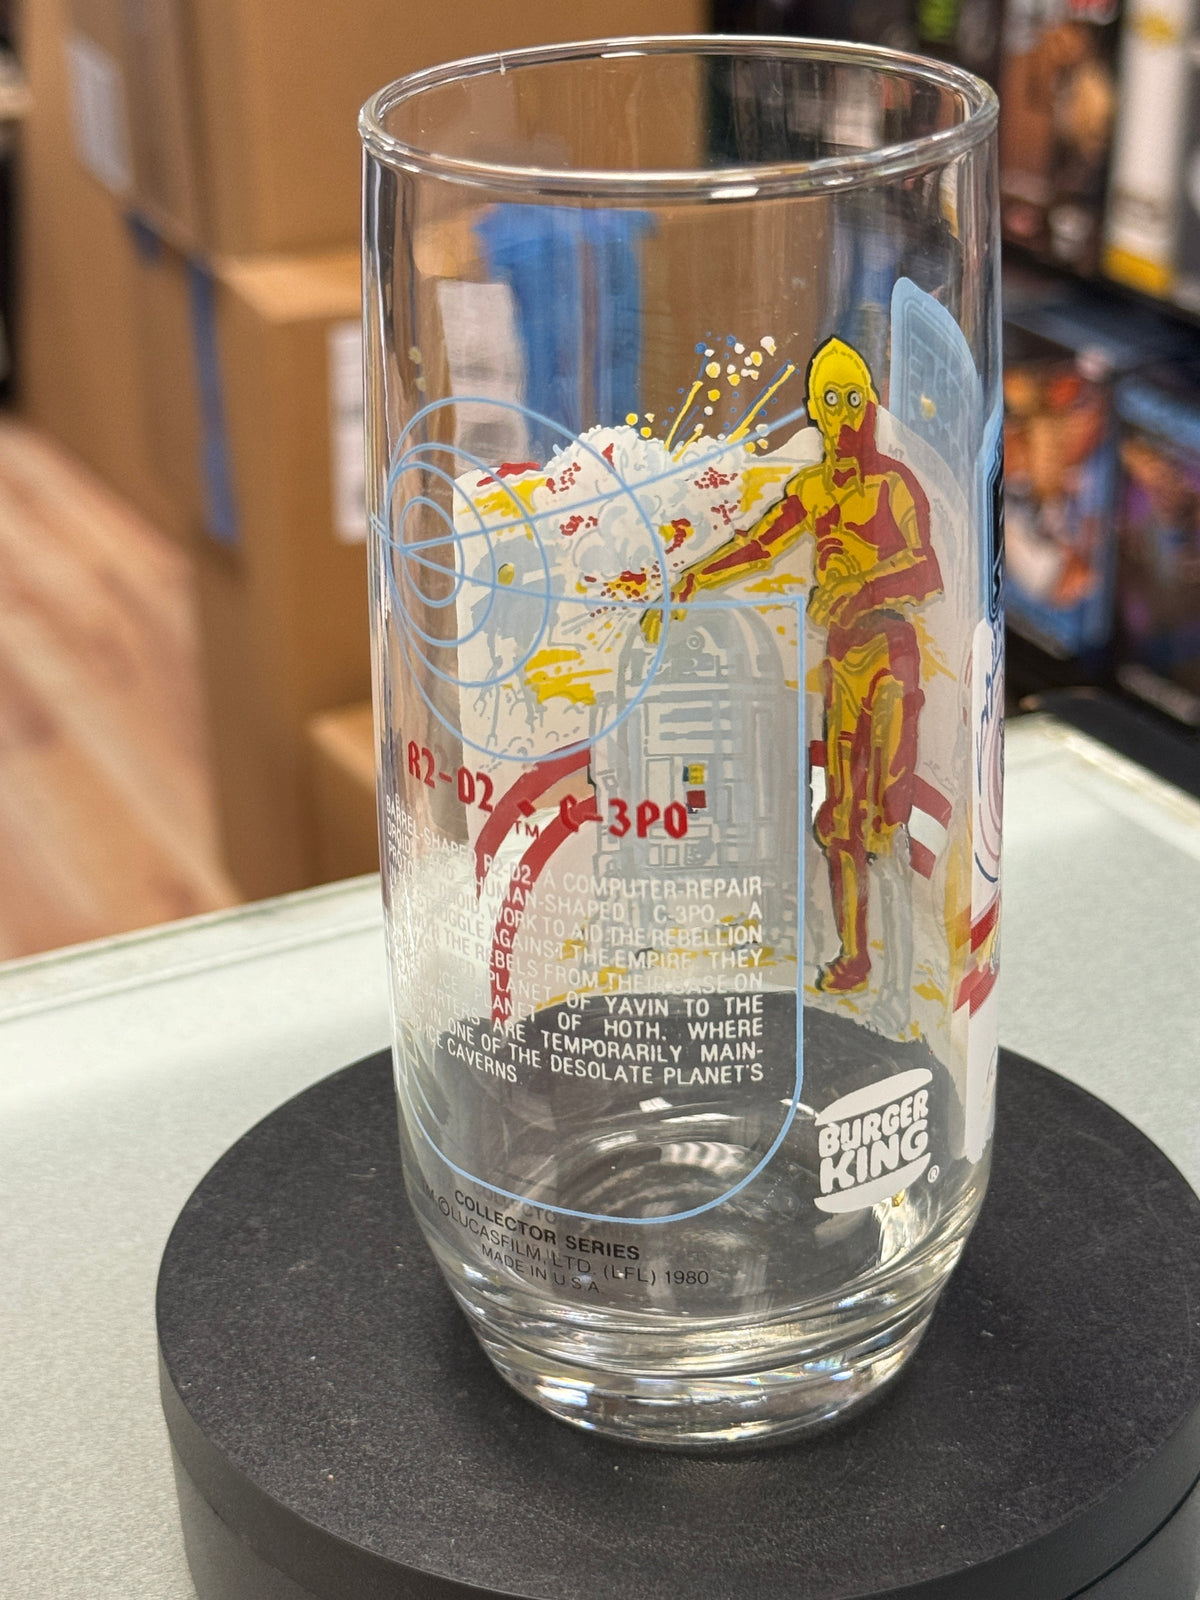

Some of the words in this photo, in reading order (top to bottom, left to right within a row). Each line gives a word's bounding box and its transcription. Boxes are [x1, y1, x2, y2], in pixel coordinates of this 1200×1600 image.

[514, 820, 540, 839] TM
[559, 794, 689, 839] C-3PO
[543, 868, 556, 890] A
[562, 871, 762, 901] COMPUTER-REPAIR
[489, 900, 538, 934] WORK
[541, 917, 565, 937] TO
[571, 922, 603, 943] AID
[611, 926, 646, 946] THE
[652, 925, 762, 948] REBELLION
[749, 901, 763, 920] A
[475, 941, 538, 978] REBELS
[544, 963, 599, 989] FROM
[734, 971, 763, 992] ON
[491, 926, 566, 961] AGAINST
[571, 943, 609, 967] THE
[708, 948, 763, 969] THEY
[473, 986, 536, 1023] PLANET
[557, 1012, 582, 1032] OF
[688, 1017, 763, 1040] WHERE
[489, 971, 552, 999] PLANET
[566, 990, 590, 1011] OF
[604, 996, 669, 1017] YAVIN
[683, 998, 710, 1017] TO
[724, 994, 764, 1016] THE
[448, 1016, 475, 1046] ONE
[481, 1033, 501, 1054] OF
[508, 1042, 542, 1069] THE
[550, 1054, 653, 1084] DESOLATE
[663, 1063, 764, 1085] PLANET'S
[493, 1016, 526, 1043] ARE
[541, 1029, 682, 1063] TEMPORARILY
[700, 1040, 764, 1063] MAIN-
[818, 1088, 929, 1159] BURGER
[820, 1118, 929, 1194] KING
[455, 1189, 557, 1245] COLLECTOR
[565, 1234, 640, 1261] SERIES
[481, 1243, 525, 1273] MADE
[530, 1265, 547, 1281] IN
[603, 1264, 656, 1287] (LFL)
[665, 1270, 709, 1285] 1980
